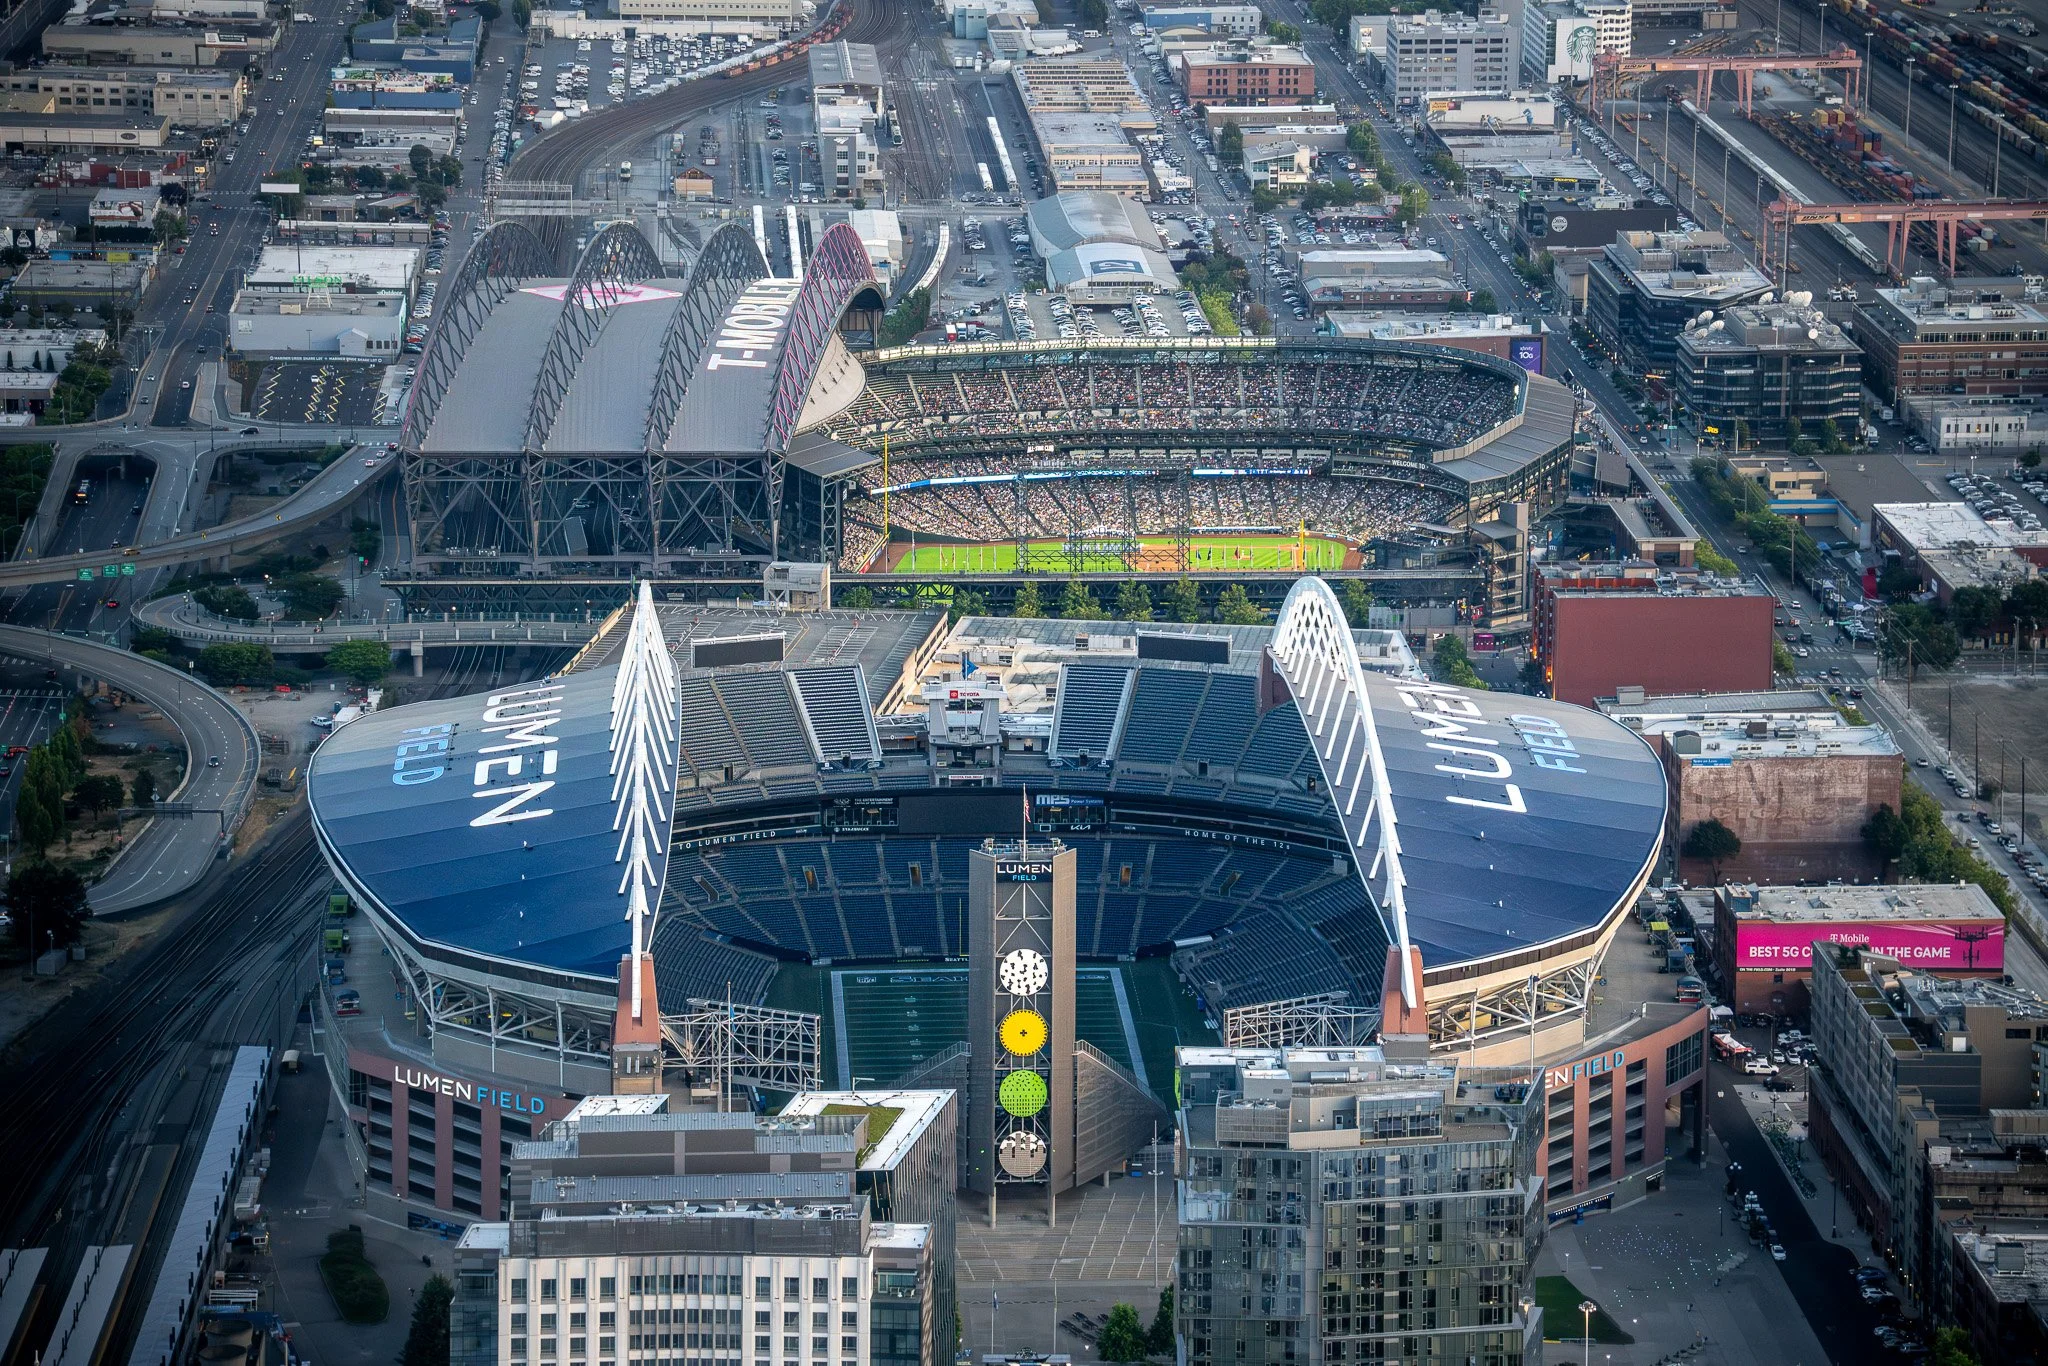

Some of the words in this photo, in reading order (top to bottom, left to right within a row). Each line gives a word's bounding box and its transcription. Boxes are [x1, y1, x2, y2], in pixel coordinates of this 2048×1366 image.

[1392, 460, 1418, 468] WELCOME
[1385, 677, 1527, 813] LUMEN
[1510, 714, 1588, 774] FIELD
[392, 723, 453, 786] FIELD
[469, 685, 566, 827] LUMEN
[1036, 795, 1069, 804] MPS
[698, 836, 736, 847] LUMEN
[743, 830, 776, 840] FIELD
[1185, 829, 1217, 839] HOME
[1245, 837, 1265, 846] THE
[997, 864, 1052, 873] LUMEN
[1840, 933, 1870, 943] Mobile
[1749, 946, 1780, 957] BEST
[1782, 946, 1800, 957] 5G
[1889, 947, 1911, 957] THE
[1912, 947, 1950, 958] GAME
[1572, 1051, 1625, 1081] FIELD
[394, 1065, 472, 1100] LUMEN
[477, 1086, 545, 1114] FIELD
